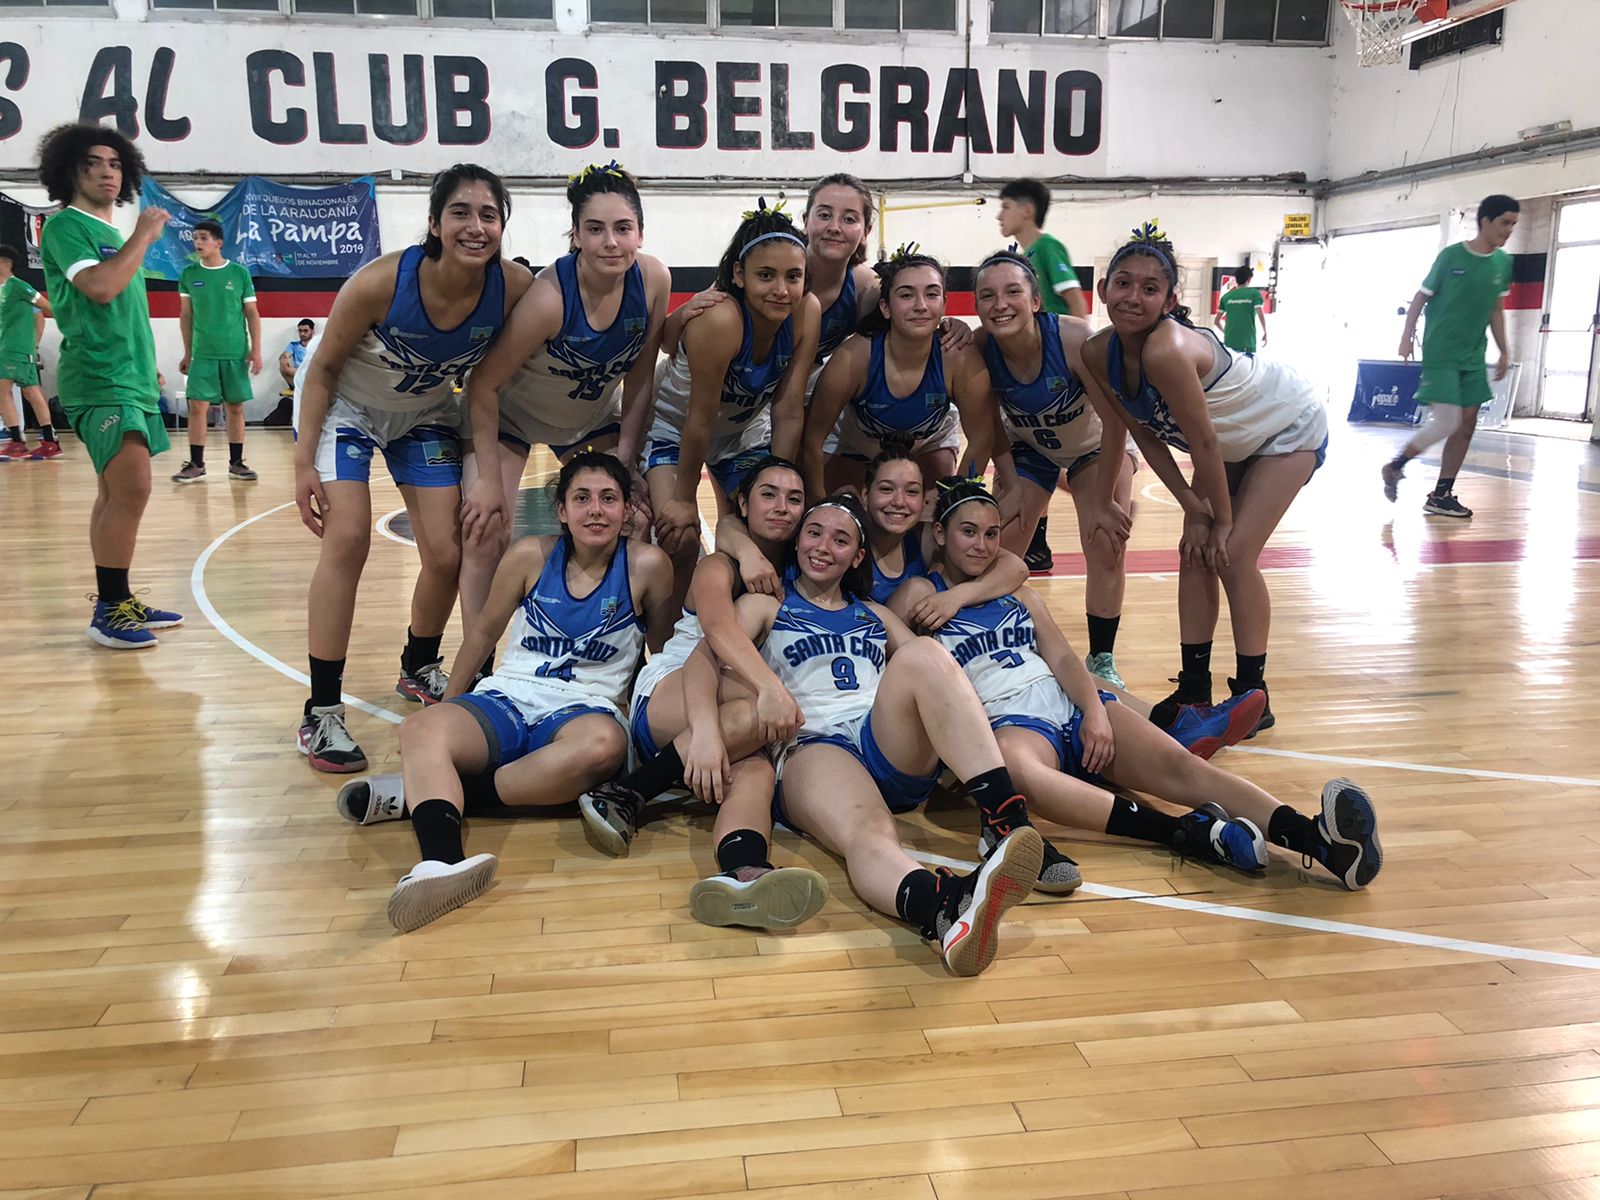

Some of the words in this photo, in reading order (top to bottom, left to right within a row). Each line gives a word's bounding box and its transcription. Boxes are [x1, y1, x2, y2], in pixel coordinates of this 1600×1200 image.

[78, 45, 192, 142] AL
[246, 48, 492, 147] CLUB
[544, 57, 620, 150] G.
[654, 59, 1103, 156] BELGRANO
[243, 203, 257, 216] DE
[261, 204, 277, 216] LA
[280, 203, 358, 219] ARAUCANÍA
[297, 194, 358, 206] BINACIONALES
[236, 220, 262, 245] La
[270, 218, 364, 255] Pampa
[340, 244, 364, 255] 2019
[1033, 429, 1062, 450] 6
[783, 633, 846, 667] SANTA
[1002, 627, 1037, 650] CRU
[831, 656, 860, 691] 9
